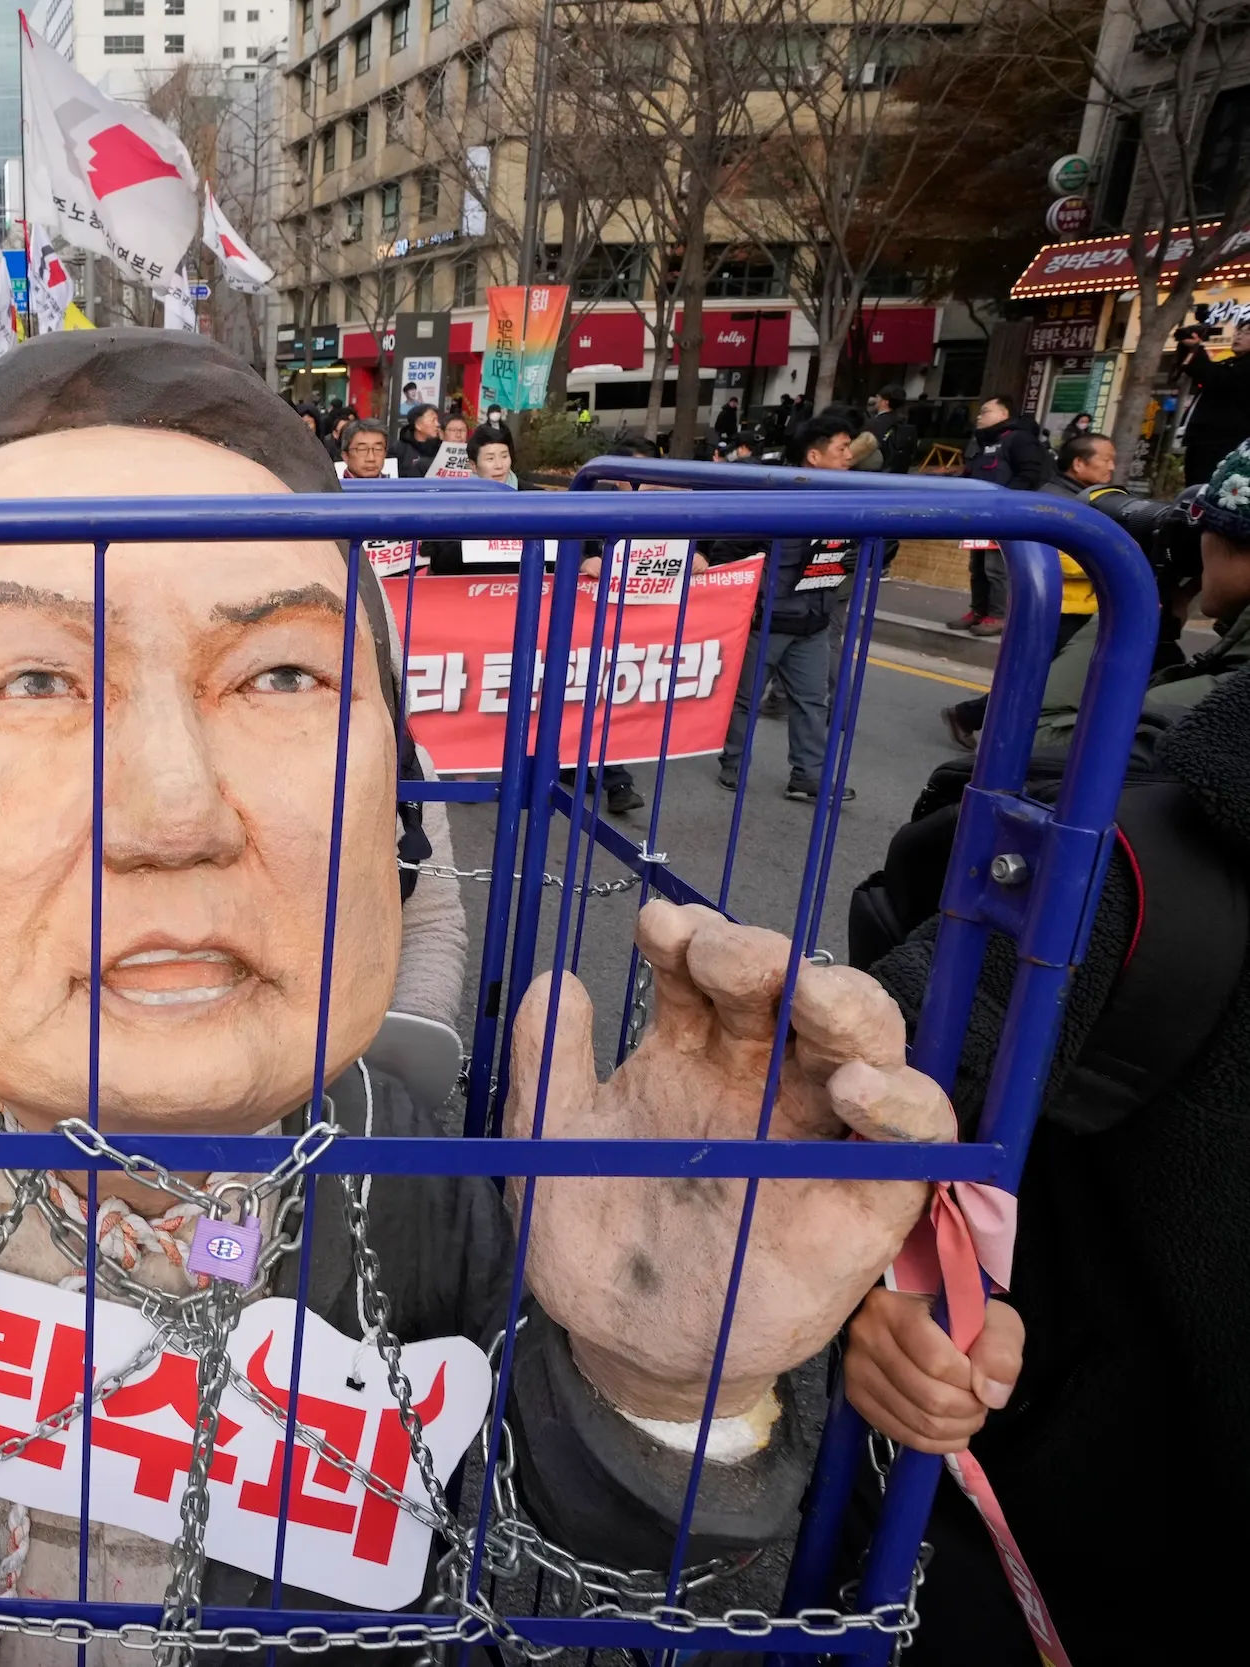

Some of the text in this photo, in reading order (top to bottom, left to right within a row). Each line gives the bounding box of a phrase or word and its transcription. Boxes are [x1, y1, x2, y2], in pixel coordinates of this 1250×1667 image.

[717, 331, 748, 347] hollys
[407, 361, 437, 370] 도시락
[731, 371, 742, 387] P
[635, 558, 683, 577] 윤석열
[709, 570, 756, 586] 비상행동
